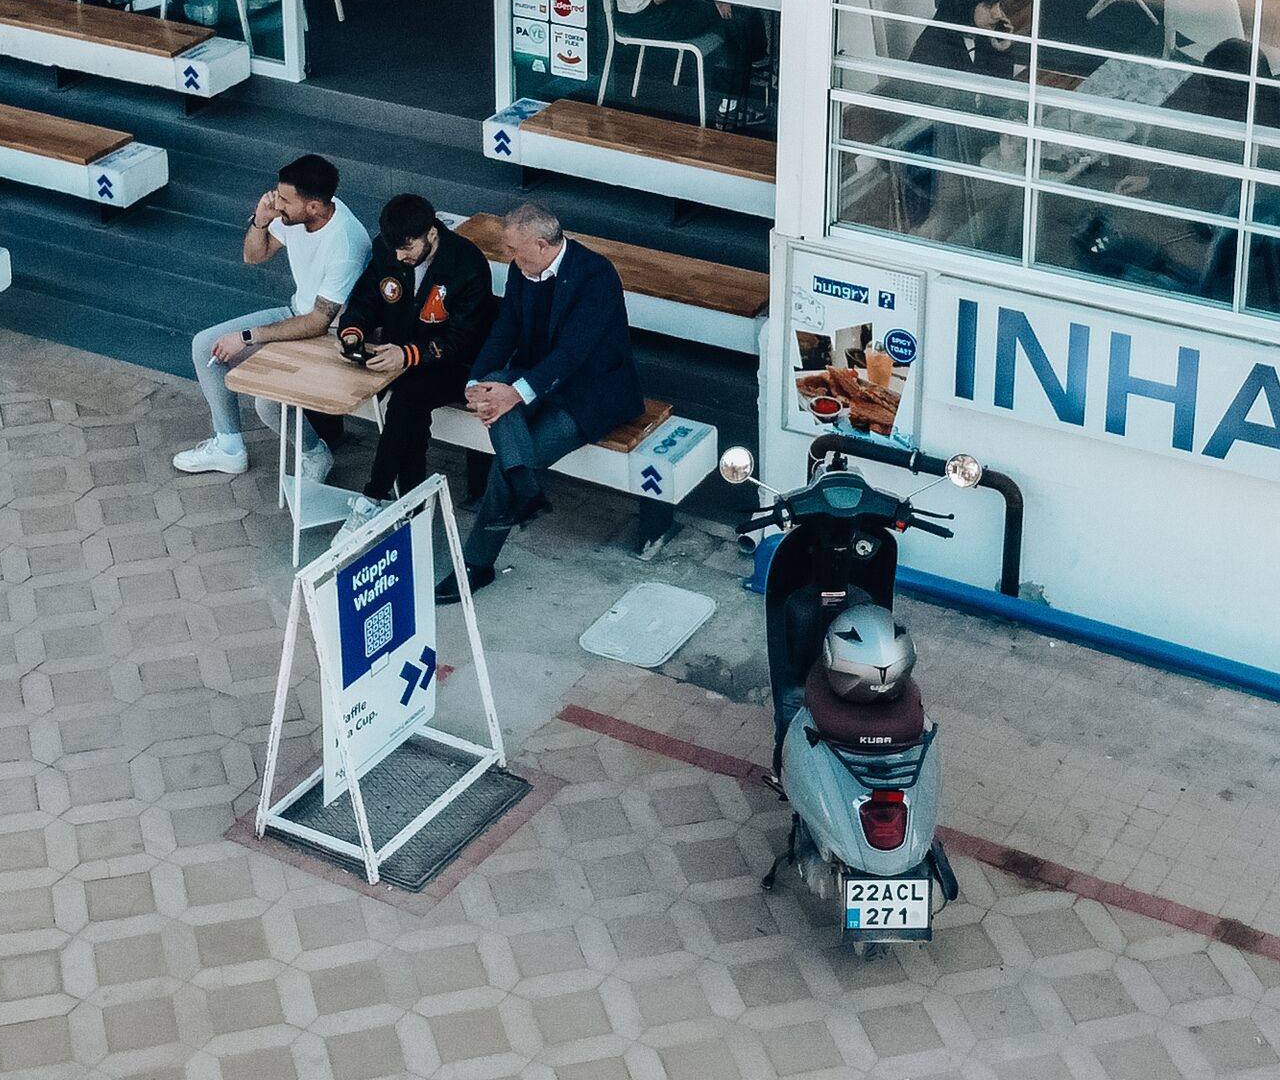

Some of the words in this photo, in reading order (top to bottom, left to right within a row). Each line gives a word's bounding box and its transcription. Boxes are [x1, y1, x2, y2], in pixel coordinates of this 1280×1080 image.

[813, 277, 869, 304] hungry
[880, 293, 892, 308] ?
[352, 549, 398, 591] Küpple
[353, 574, 400, 612] Waffle.
[343, 700, 368, 724] affle
[355, 711, 379, 732] Cup.
[851, 883, 924, 902] 22ACL
[866, 907, 908, 926] 271
